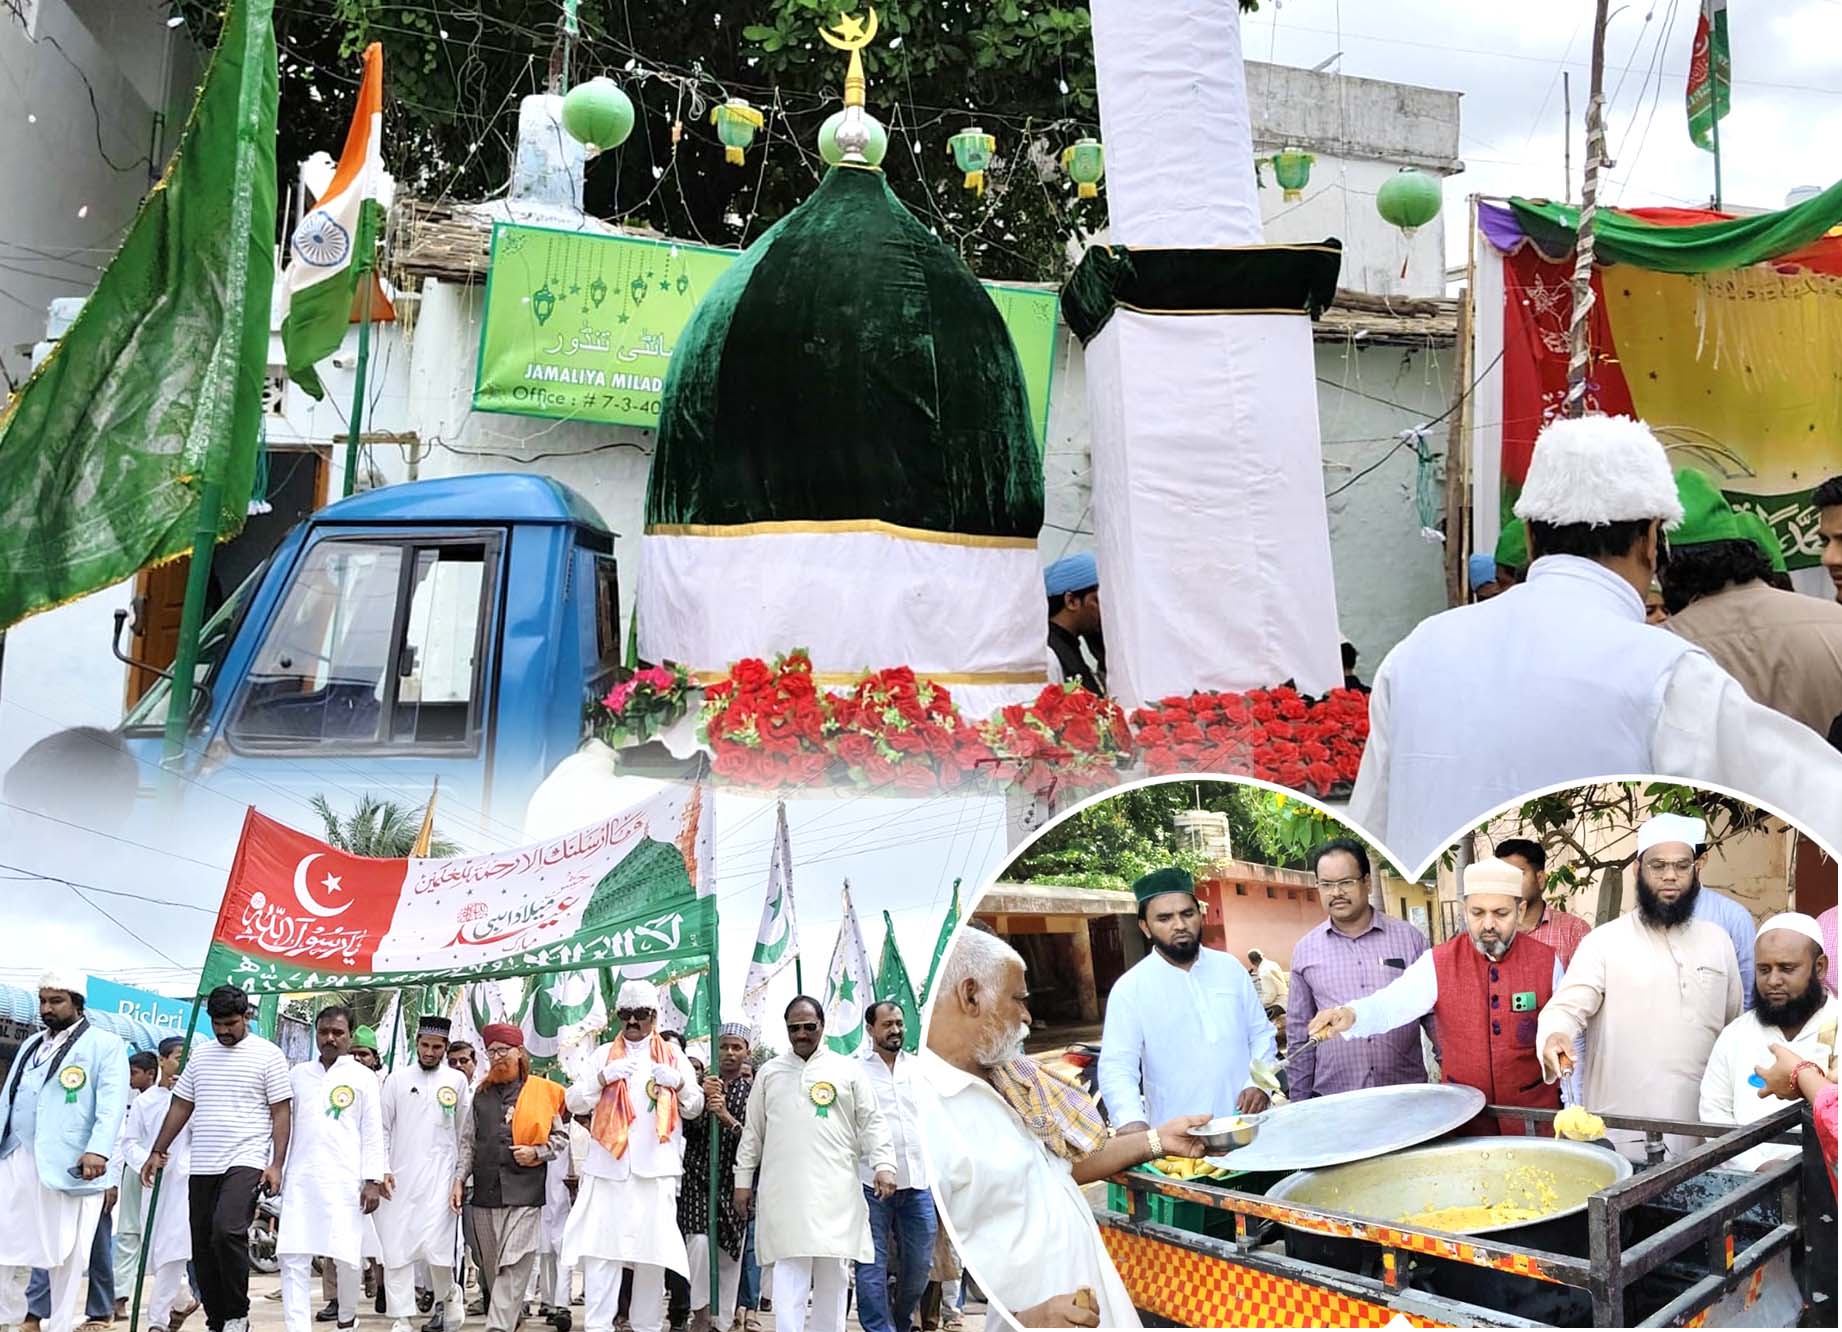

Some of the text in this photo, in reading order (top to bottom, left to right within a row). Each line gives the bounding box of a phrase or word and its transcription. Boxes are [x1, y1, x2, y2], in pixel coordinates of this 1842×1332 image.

[524, 363, 663, 393] JAMALIYA MILAD
[512, 385, 566, 406] Office
[582, 393, 597, 408] #
